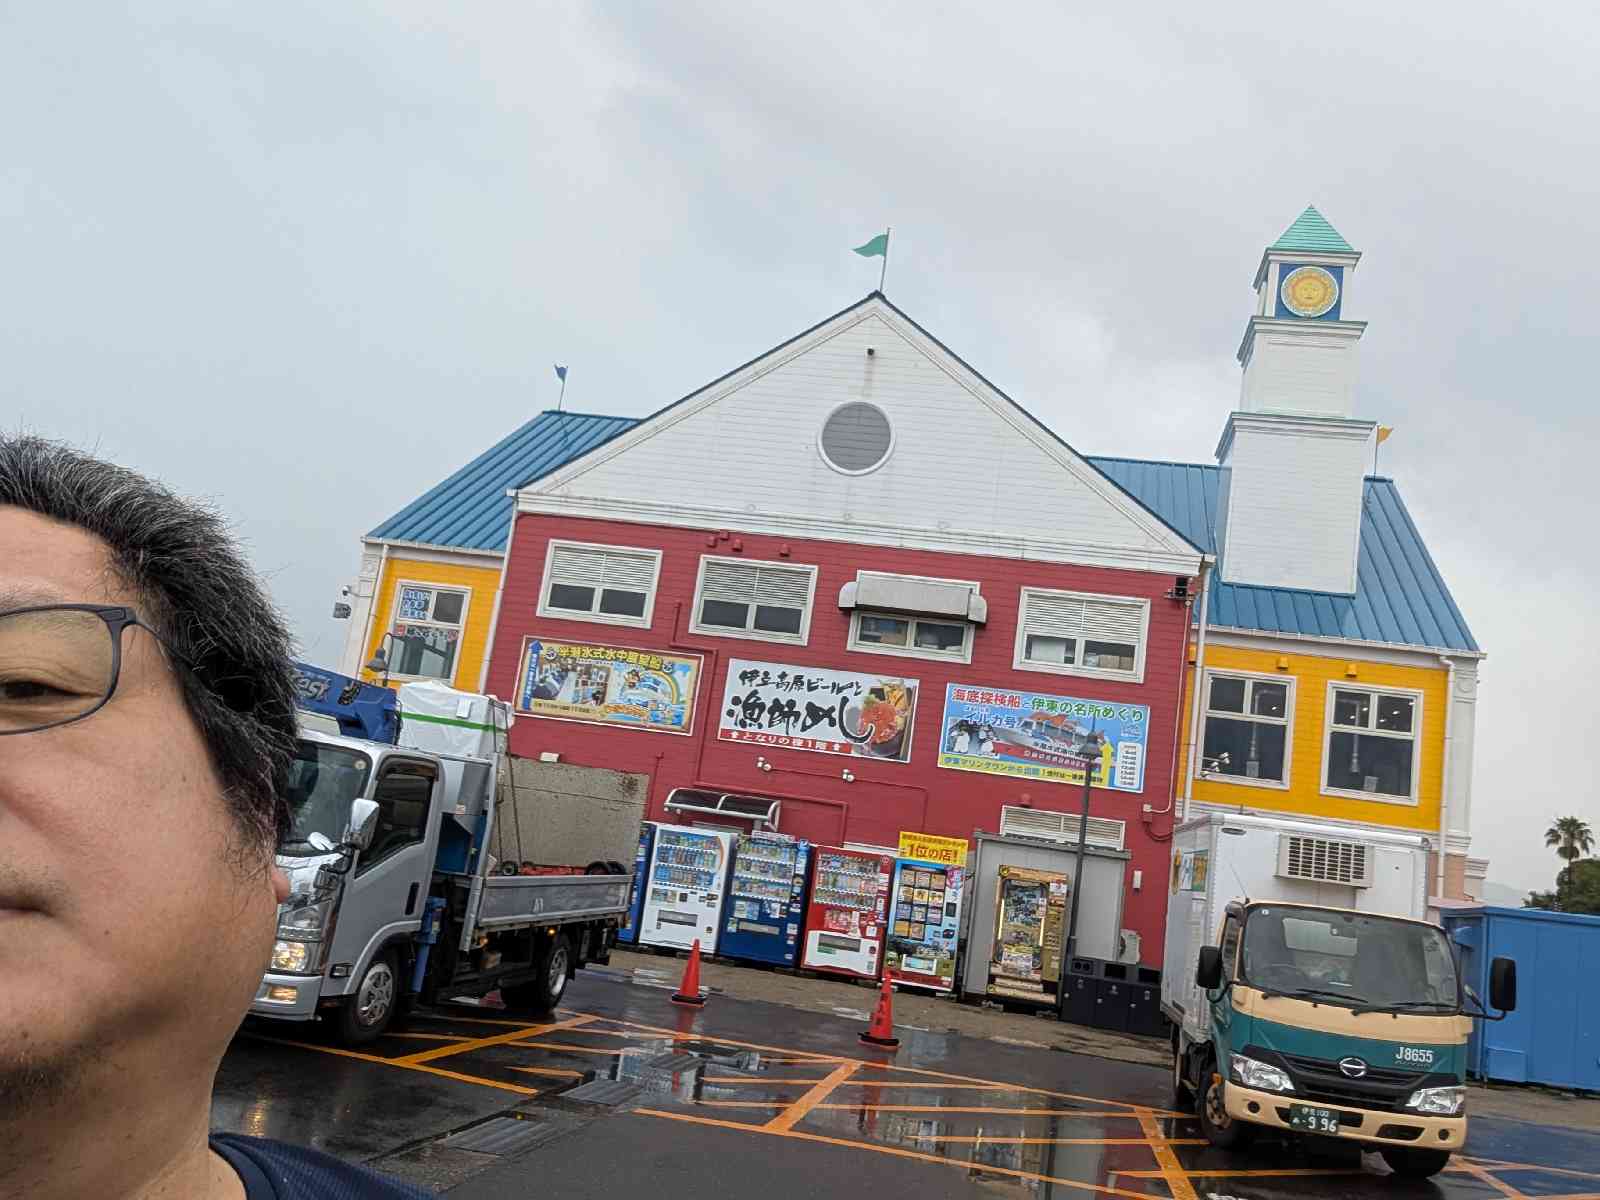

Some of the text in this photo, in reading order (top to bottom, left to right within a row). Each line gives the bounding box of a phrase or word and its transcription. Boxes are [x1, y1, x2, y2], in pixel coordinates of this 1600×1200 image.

[726, 689, 876, 743] 漁師めし
[1395, 1046, 1434, 1063] J8655
